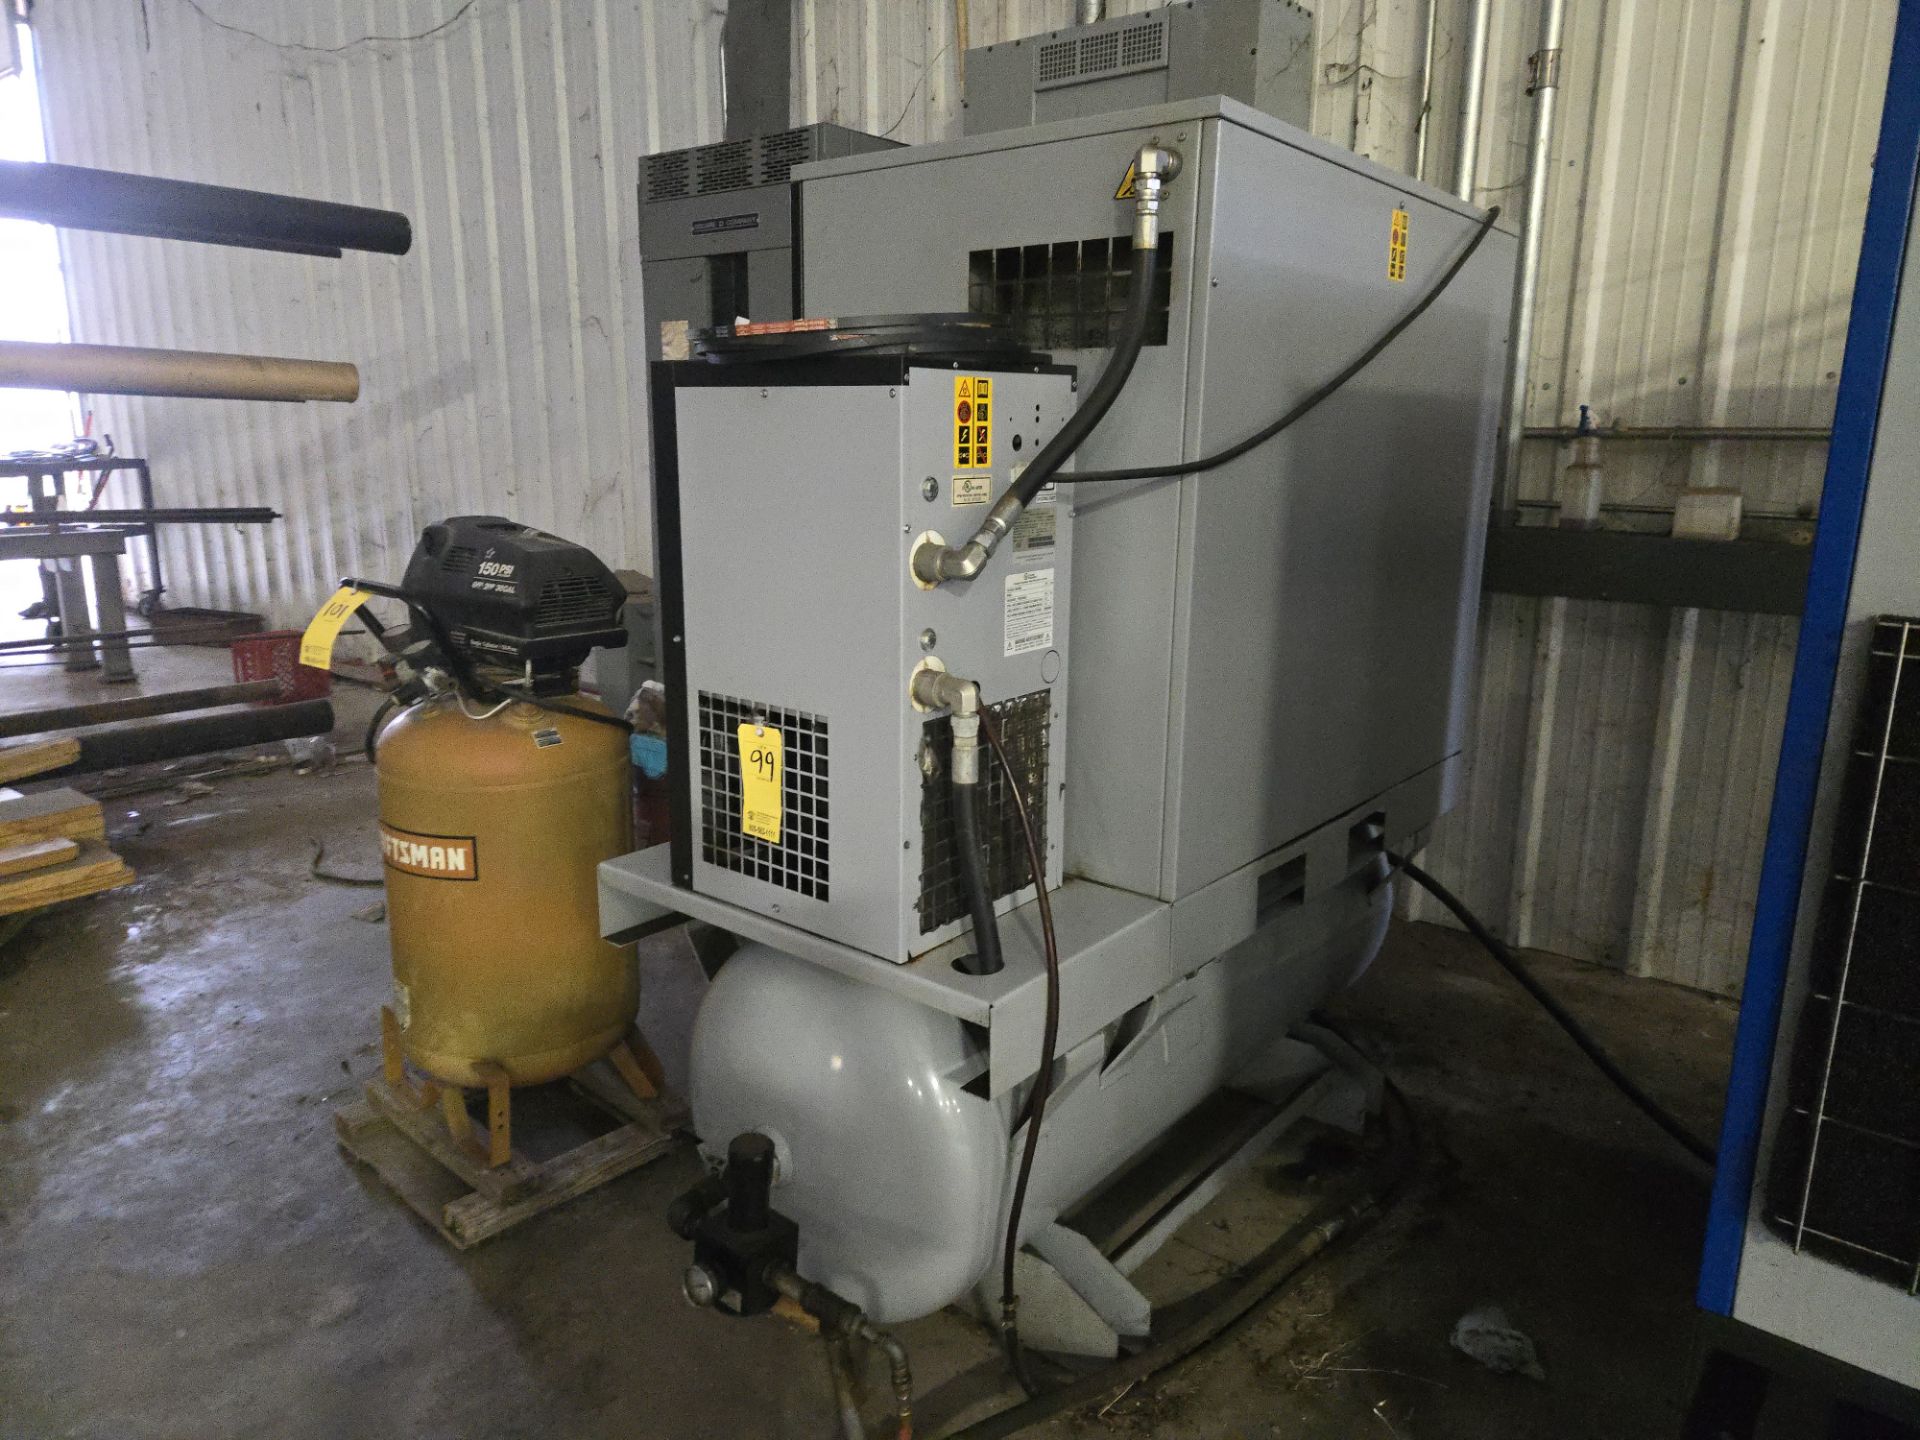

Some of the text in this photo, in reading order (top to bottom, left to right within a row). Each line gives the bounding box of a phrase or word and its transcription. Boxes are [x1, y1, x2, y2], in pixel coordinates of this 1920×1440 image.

[478, 561, 515, 576] 150 PSI
[750, 749, 774, 783] 99
